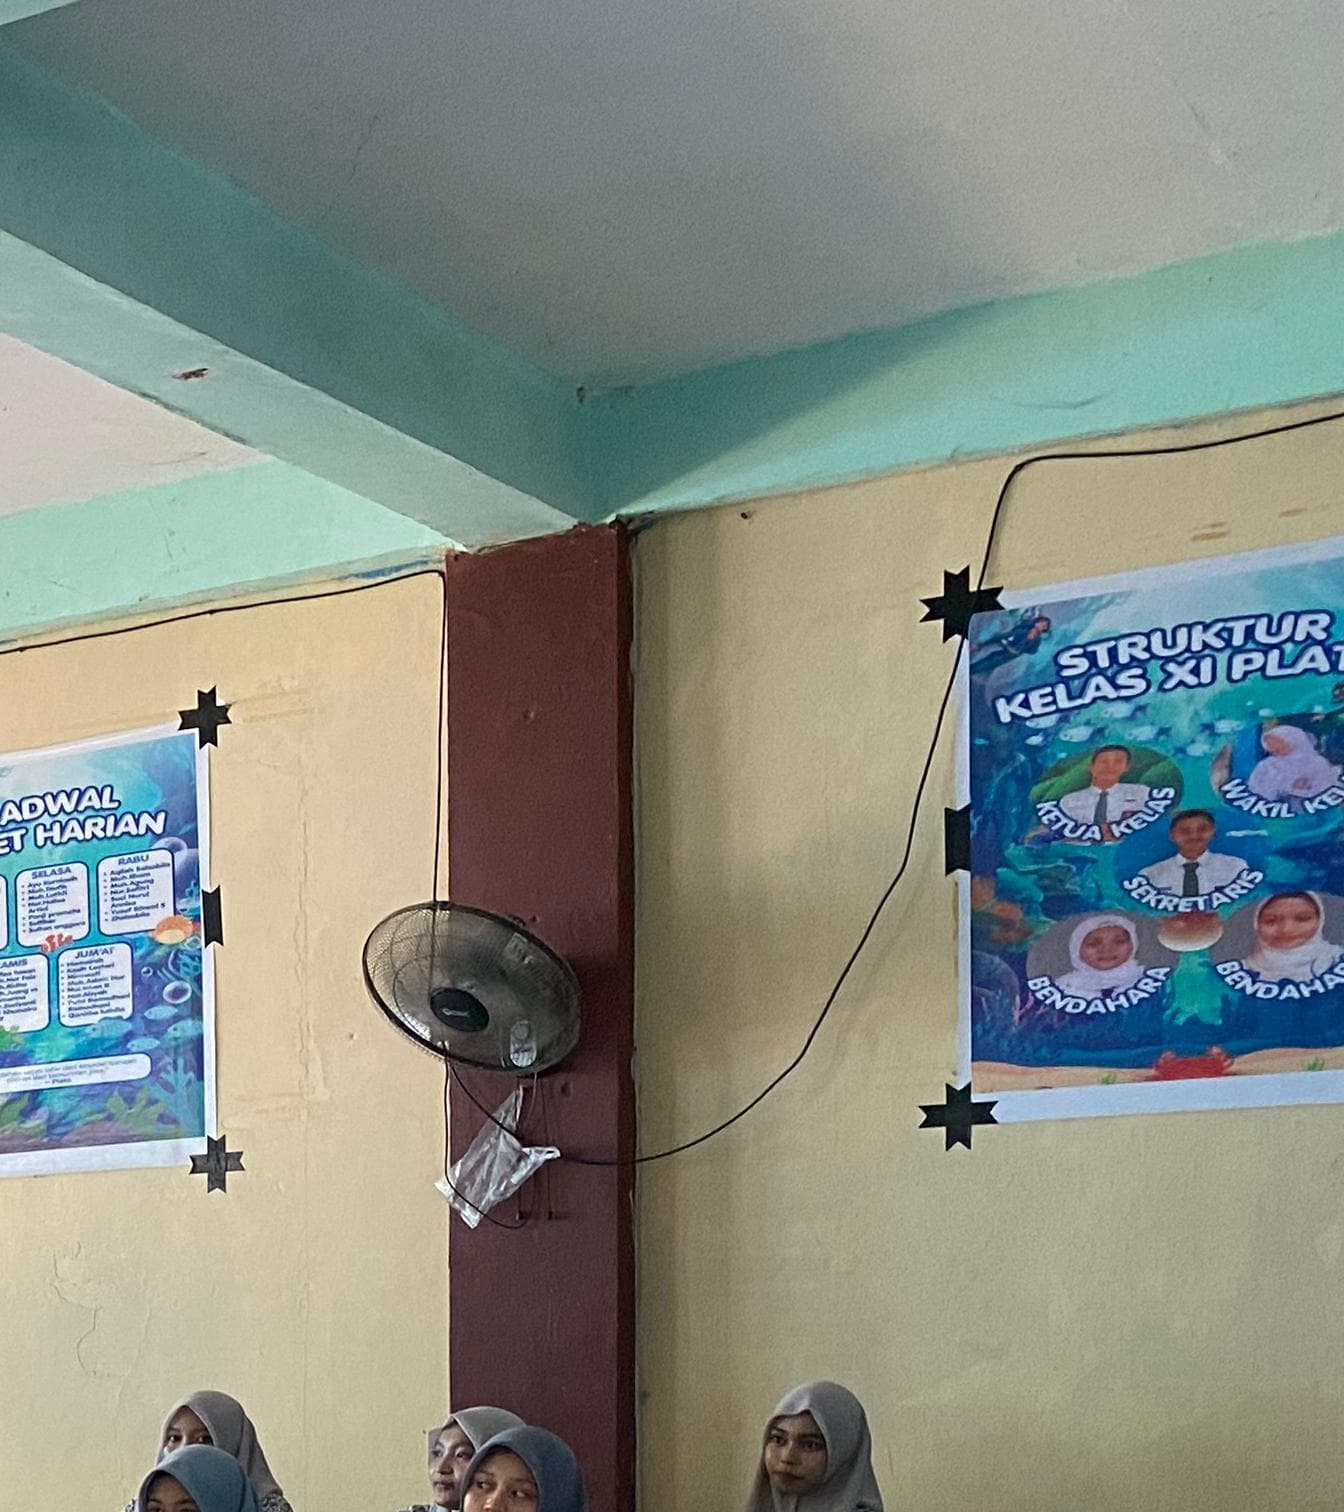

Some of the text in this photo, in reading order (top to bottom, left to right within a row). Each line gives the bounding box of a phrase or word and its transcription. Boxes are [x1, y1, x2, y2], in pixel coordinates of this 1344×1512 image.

[1059, 611, 1333, 677] STRUKTUR
[995, 667, 1148, 724] KELAS
[1162, 655, 1217, 690] XI
[1036, 786, 1177, 841] KETUA KELAS
[1221, 777, 1296, 818] WAKIL
[34, 811, 167, 848] HARIAN
[32, 866, 72, 879] SELASA
[118, 854, 149, 865] RABU
[1123, 868, 1264, 913] SEKRETARIS
[1027, 965, 1171, 1015] BENDAHARA
